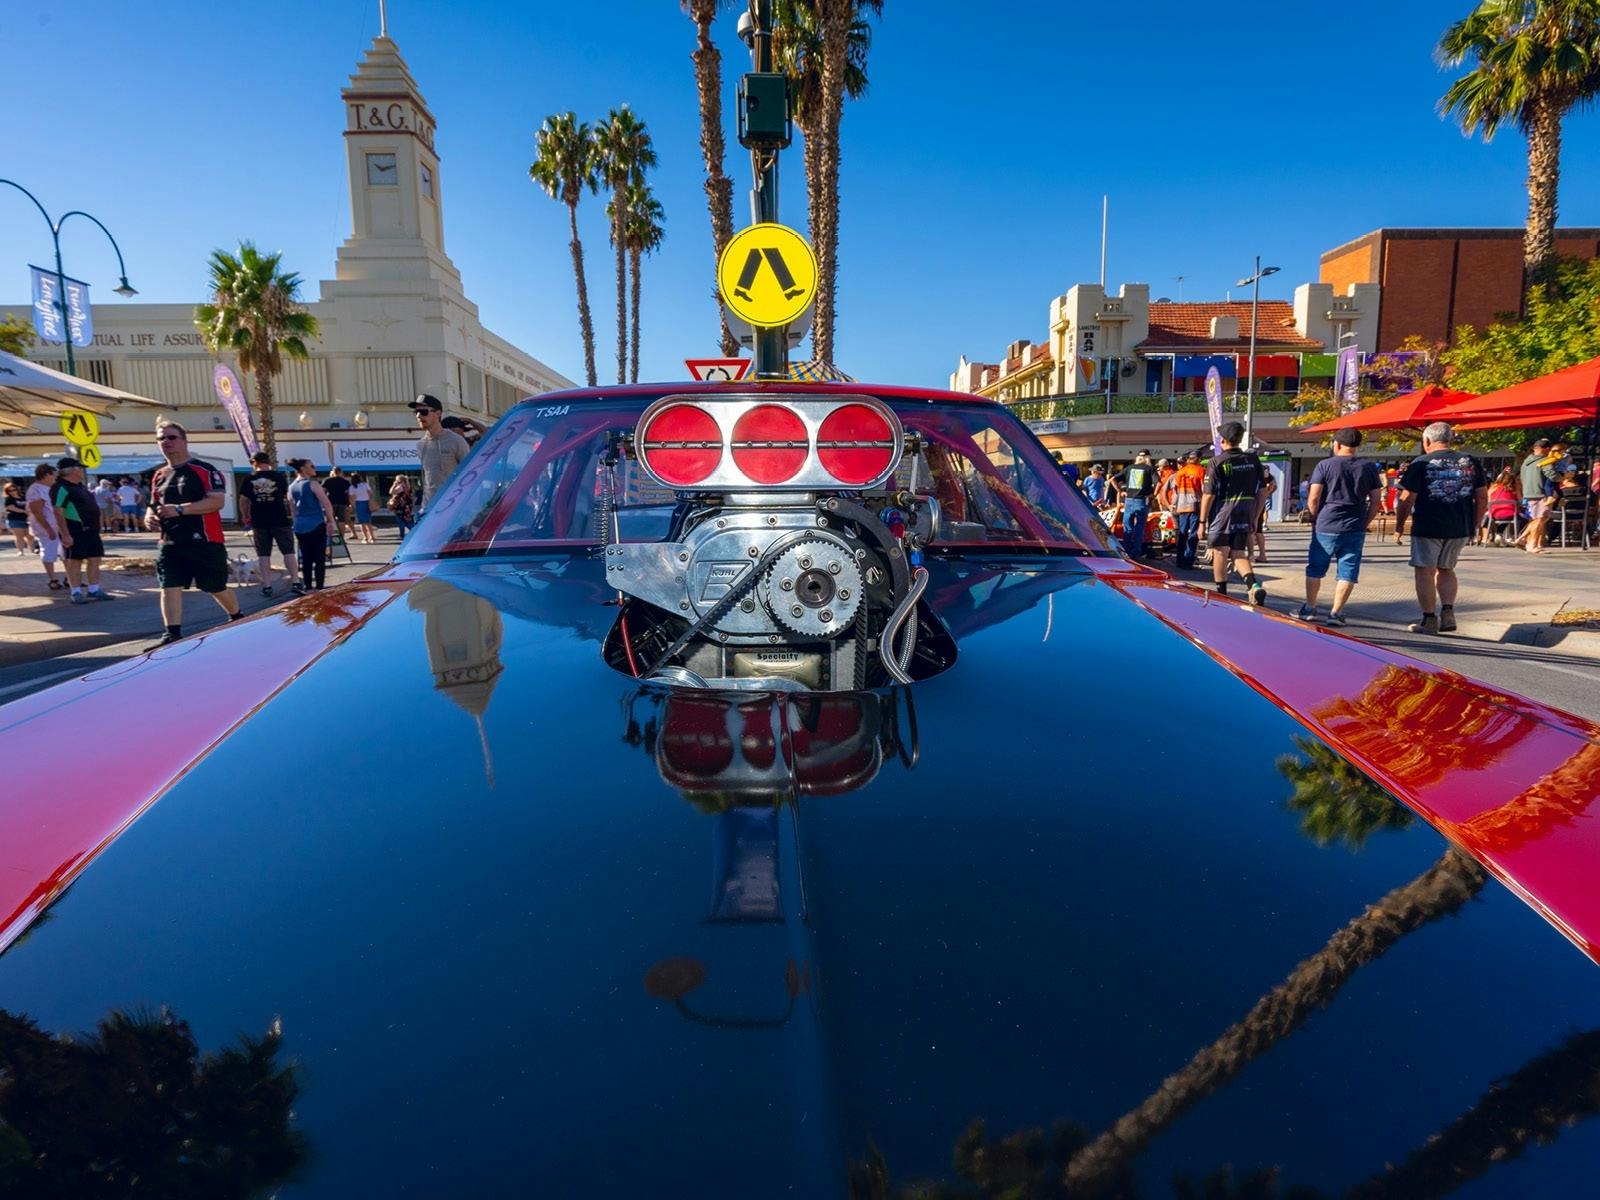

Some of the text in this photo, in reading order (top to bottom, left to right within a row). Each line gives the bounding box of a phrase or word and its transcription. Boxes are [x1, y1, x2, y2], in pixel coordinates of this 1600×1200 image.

[130, 334, 156, 346] LIFE
[536, 405, 570, 418] TSAA
[340, 447, 418, 461] bluefrogoptics
[756, 653, 799, 661] Specialty
